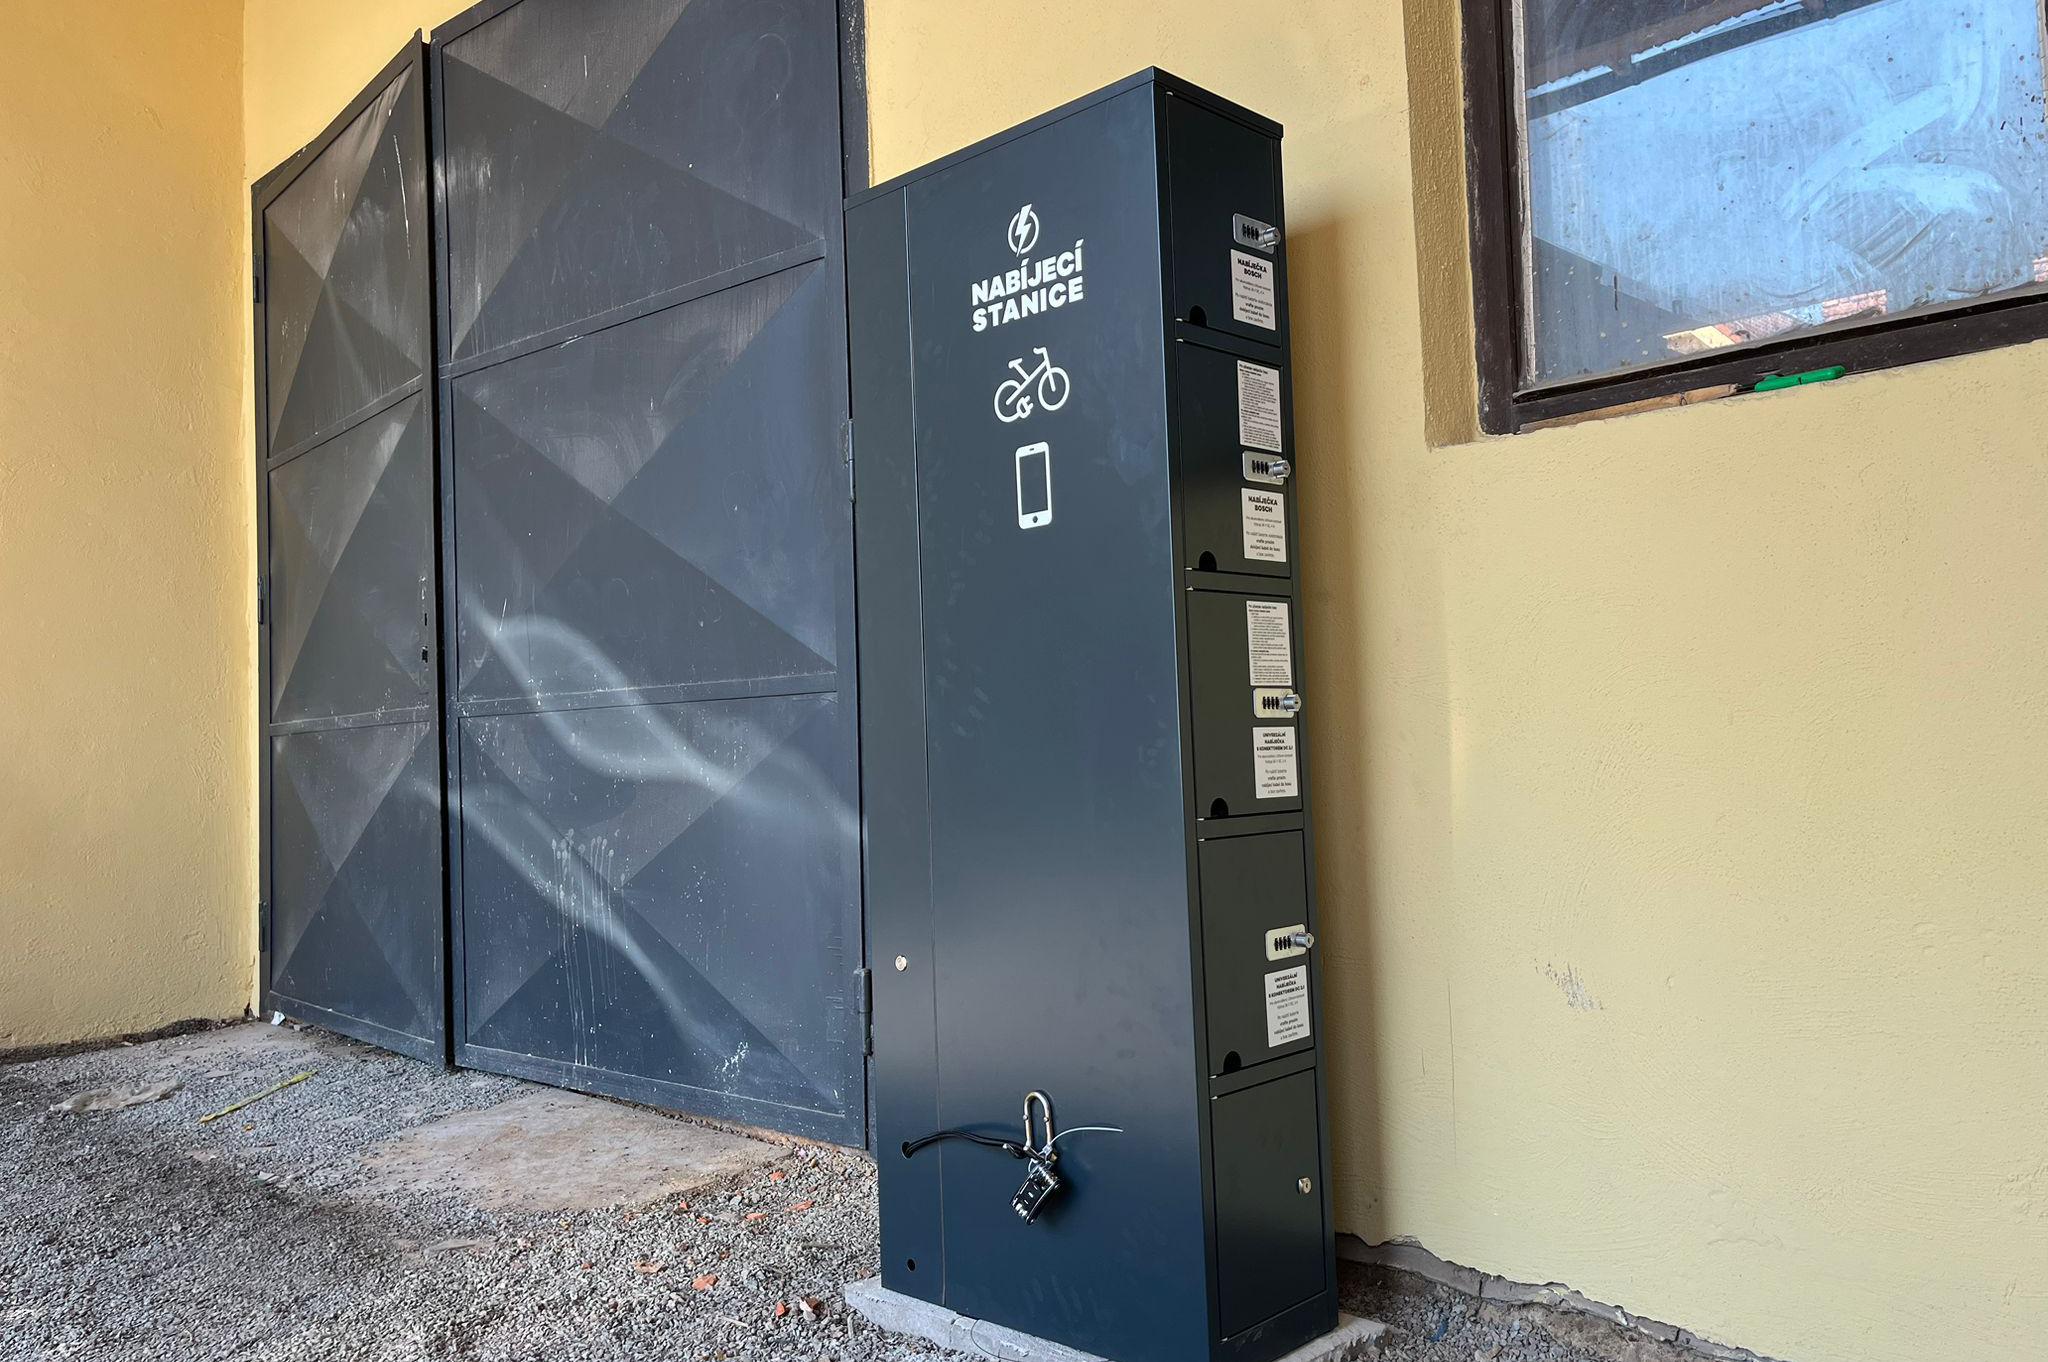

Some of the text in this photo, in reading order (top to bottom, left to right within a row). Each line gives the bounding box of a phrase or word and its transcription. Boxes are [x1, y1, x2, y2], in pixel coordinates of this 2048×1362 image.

[971, 239, 1084, 306] NABÍJECÍ
[1244, 268, 1262, 279] BOSCH
[972, 275, 1084, 332] STANICE
[1248, 495, 1278, 505] NABÍJEČKA
[1255, 505, 1273, 513] BOSCH
